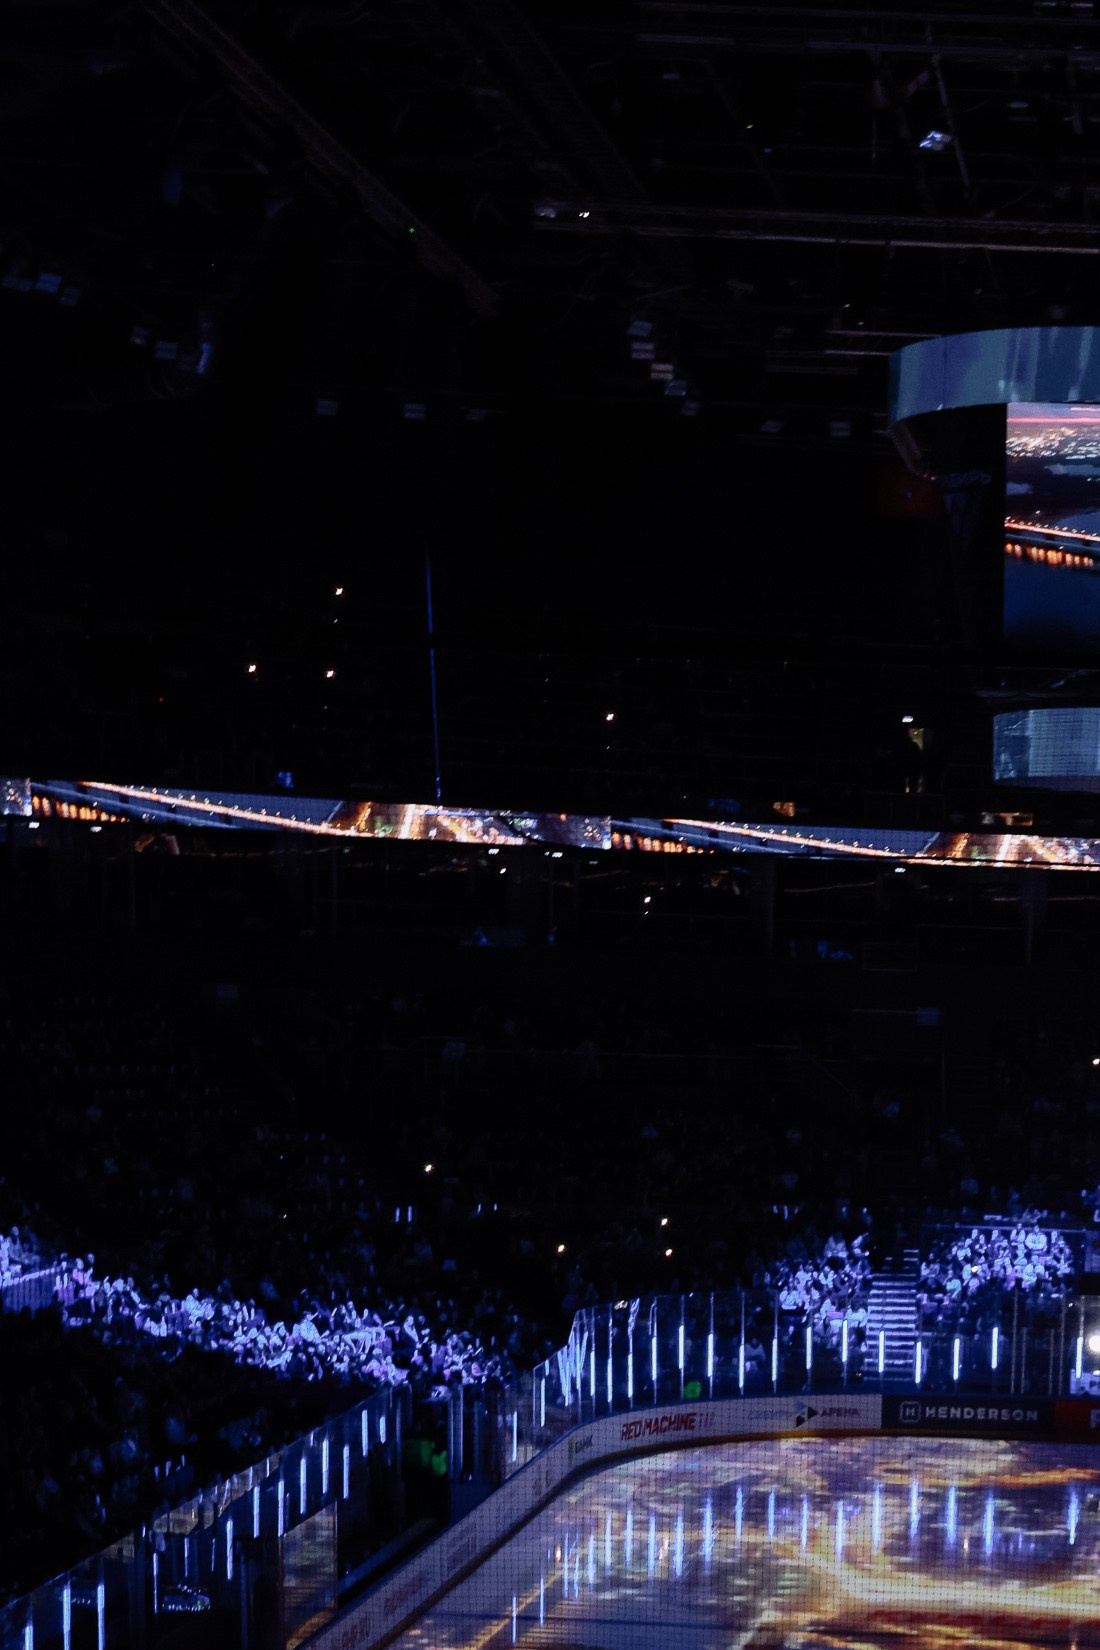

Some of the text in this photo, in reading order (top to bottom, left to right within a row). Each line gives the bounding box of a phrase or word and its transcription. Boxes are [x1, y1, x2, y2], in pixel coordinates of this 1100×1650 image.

[925, 1405, 1039, 1422] HENDERSON
[620, 1412, 697, 1442] RED MACHINE
